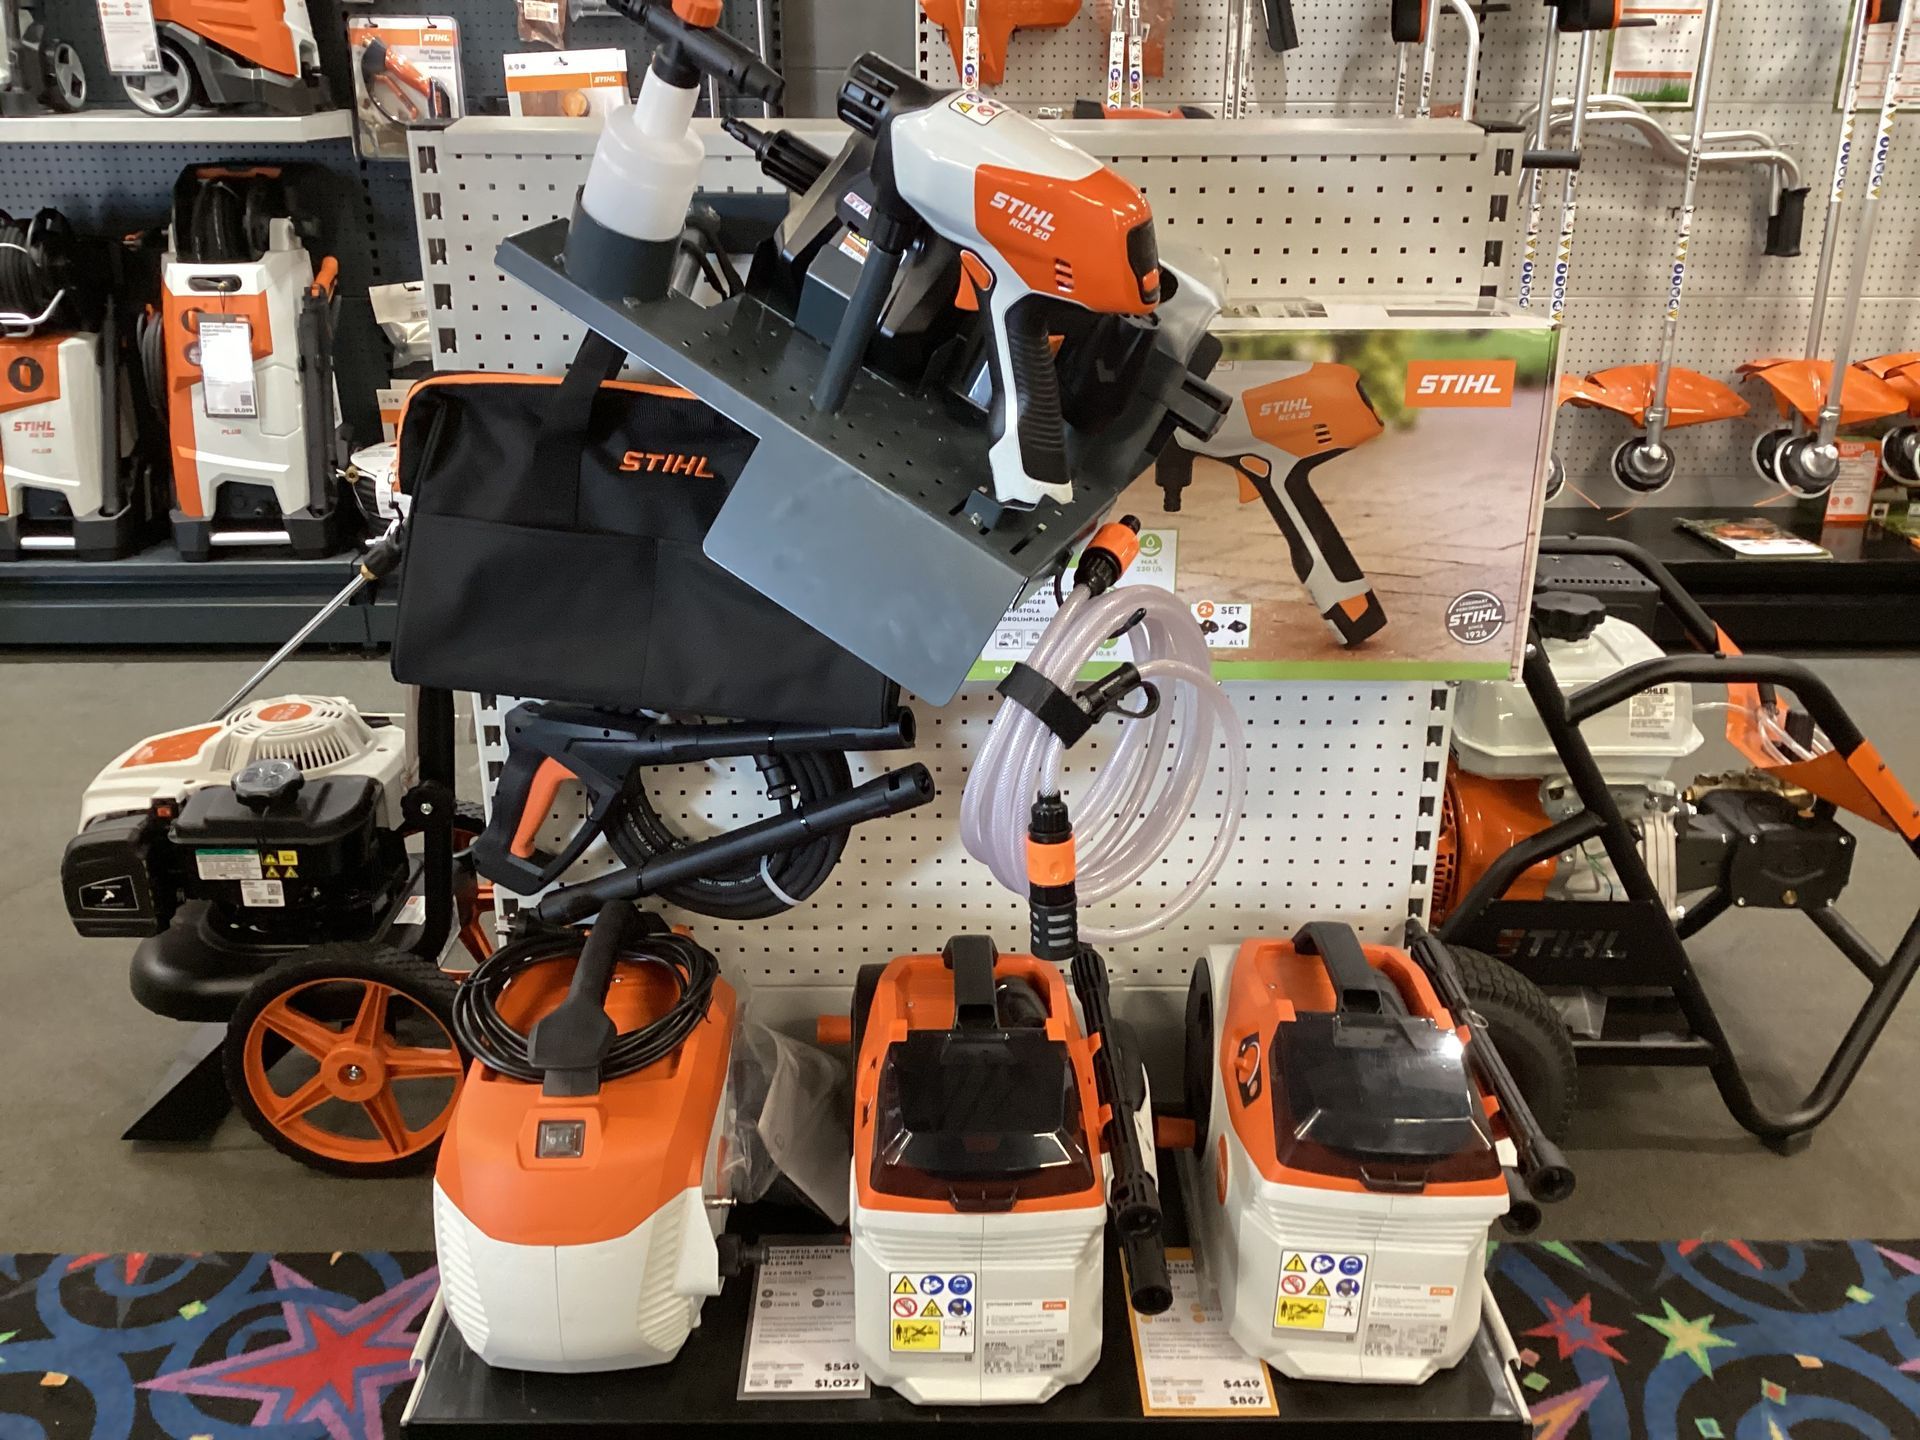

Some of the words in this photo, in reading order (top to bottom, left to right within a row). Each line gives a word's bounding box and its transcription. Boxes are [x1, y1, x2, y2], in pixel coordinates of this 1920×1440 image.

[422, 33, 450, 42] STIHL
[593, 75, 617, 84] STIHL
[990, 191, 1056, 232] STIHL
[1008, 217, 1033, 235] RCA
[1032, 228, 1051, 242] 20
[1417, 374, 1502, 394] STIHL
[1260, 397, 1313, 417] STIHL
[1278, 413, 1297, 422] RCA
[1298, 410, 1312, 420] 20
[13, 421, 56, 432] STIHL
[221, 428, 242, 436] PLUS
[619, 450, 715, 479] STIHL
[1220, 606, 1242, 615] SET
[1448, 608, 1503, 627] STIHL
[1465, 630, 1488, 639] 1926
[1640, 687, 1670, 695] OHLER
[1493, 927, 1627, 958] STIHL
[825, 1362, 860, 1372] $549
[815, 1378, 860, 1389] $1,027
[1223, 1379, 1261, 1389] $449
[1229, 1395, 1264, 1405] $867
